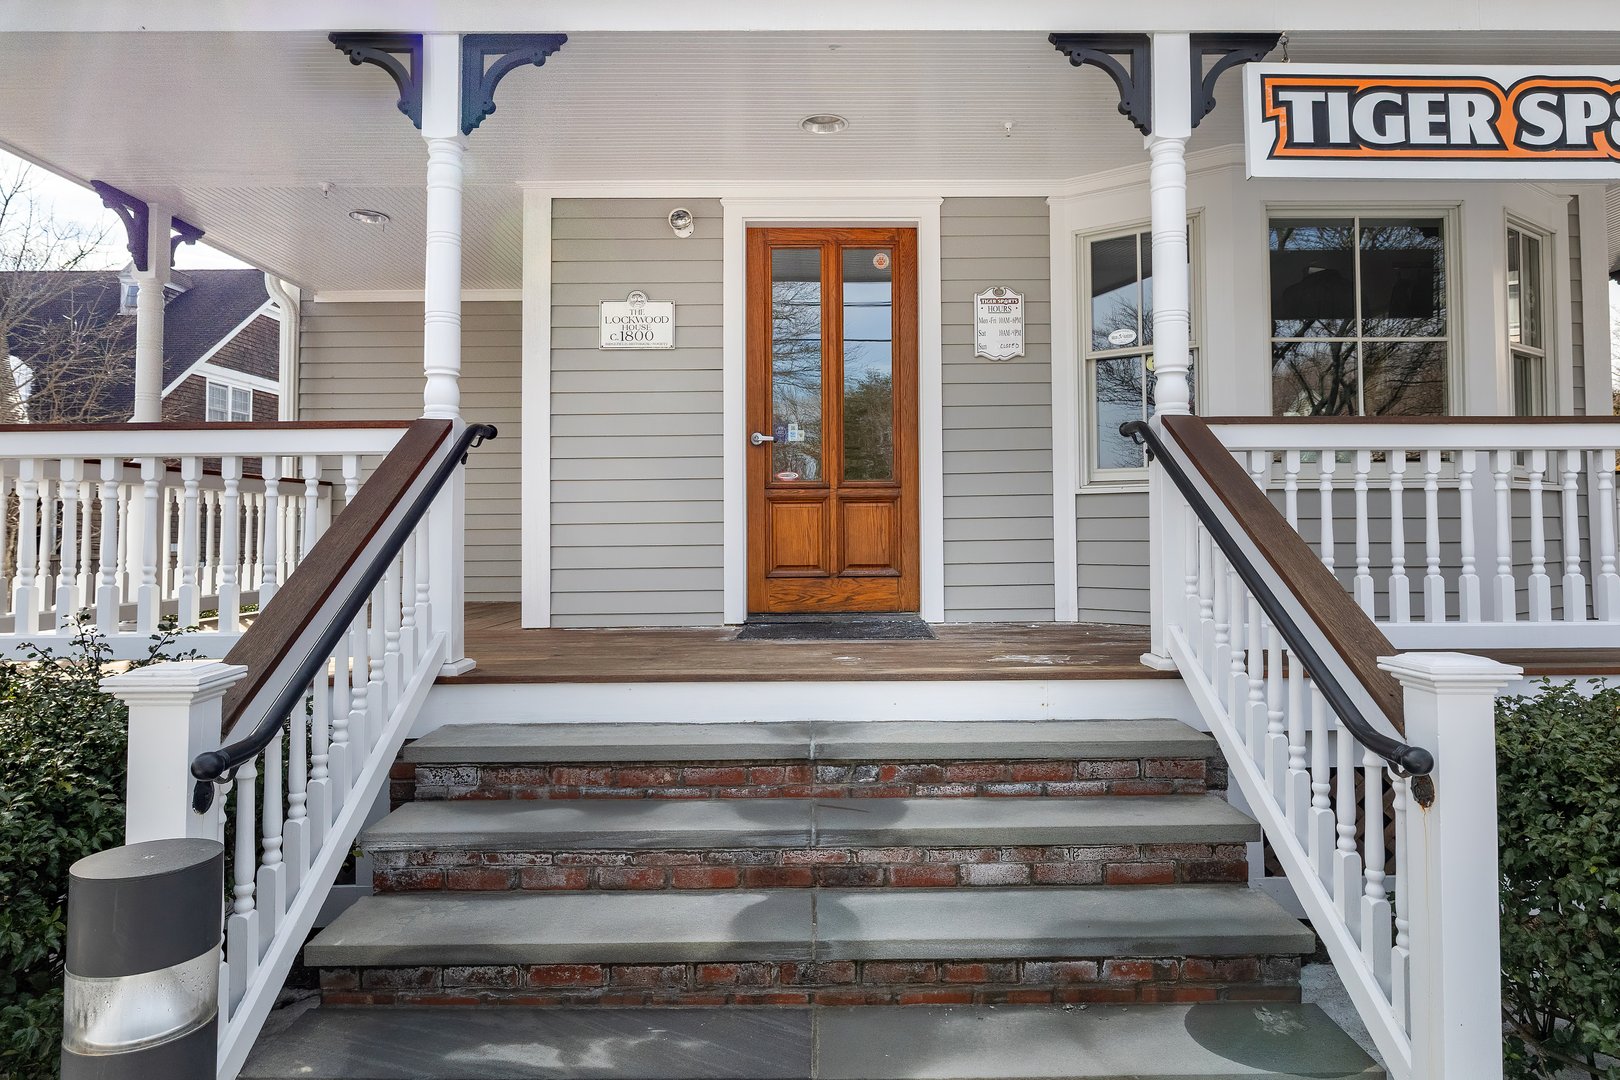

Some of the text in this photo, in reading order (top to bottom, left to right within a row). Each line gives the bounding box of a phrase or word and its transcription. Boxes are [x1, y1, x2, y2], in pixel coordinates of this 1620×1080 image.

[1278, 91, 1620, 146] TIGER SP
[629, 308, 645, 316] THE
[604, 316, 670, 324] LOCKWOOD
